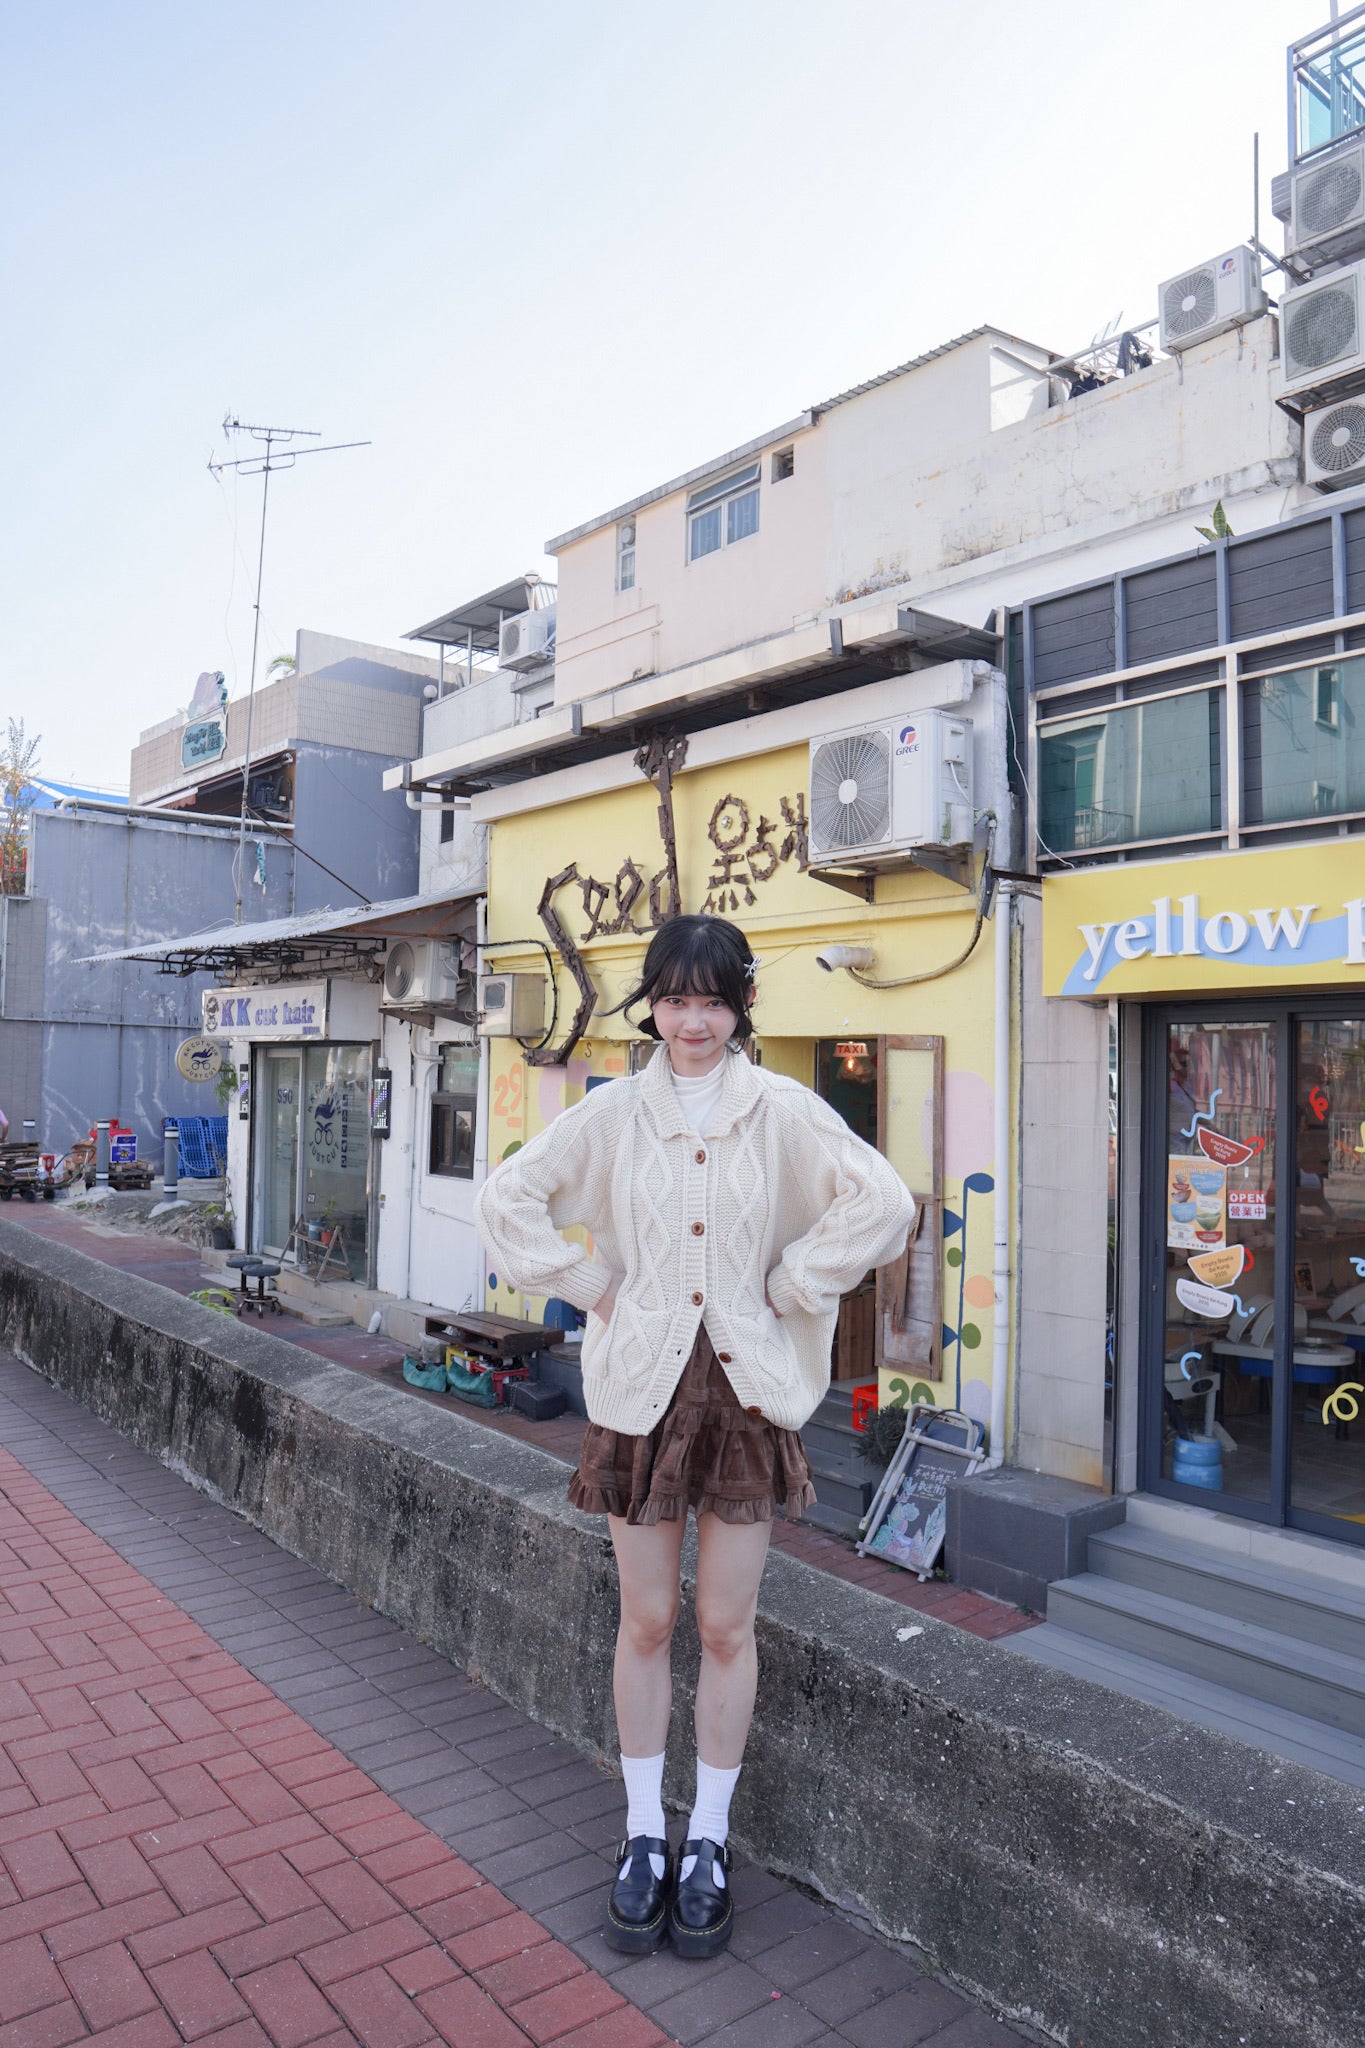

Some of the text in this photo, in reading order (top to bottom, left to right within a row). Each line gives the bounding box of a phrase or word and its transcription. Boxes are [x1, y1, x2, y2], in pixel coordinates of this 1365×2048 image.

[896, 743, 920, 756] GREE
[1077, 893, 1320, 981] yellow
[221, 998, 316, 1027] KK cut hair
[837, 1044, 864, 1054] TAXI
[493, 1062, 523, 1117] 29
[1229, 1193, 1265, 1204] OPEN
[1230, 1205, 1265, 1217] 營業中
